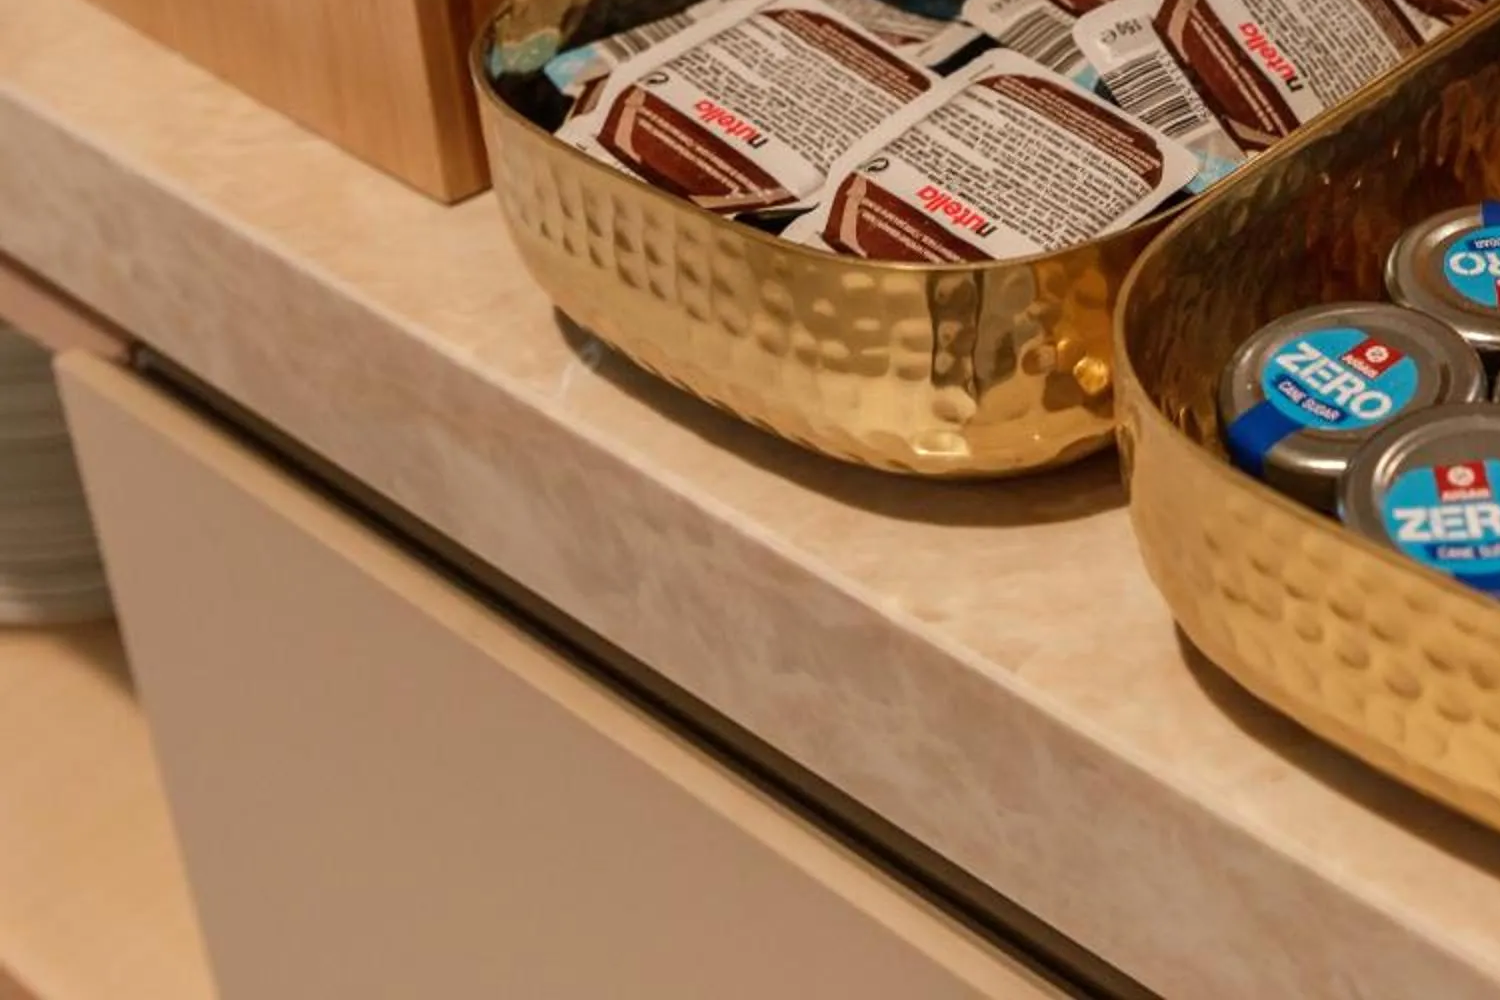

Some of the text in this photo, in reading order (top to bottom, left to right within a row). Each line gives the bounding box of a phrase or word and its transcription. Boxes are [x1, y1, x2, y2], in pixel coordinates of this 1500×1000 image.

[1239, 23, 1304, 93] nutella
[695, 100, 769, 149] nutella
[916, 185, 998, 238] nutella
[1276, 341, 1392, 419] ZERO
[1278, 380, 1340, 421] CANE SUGAR
